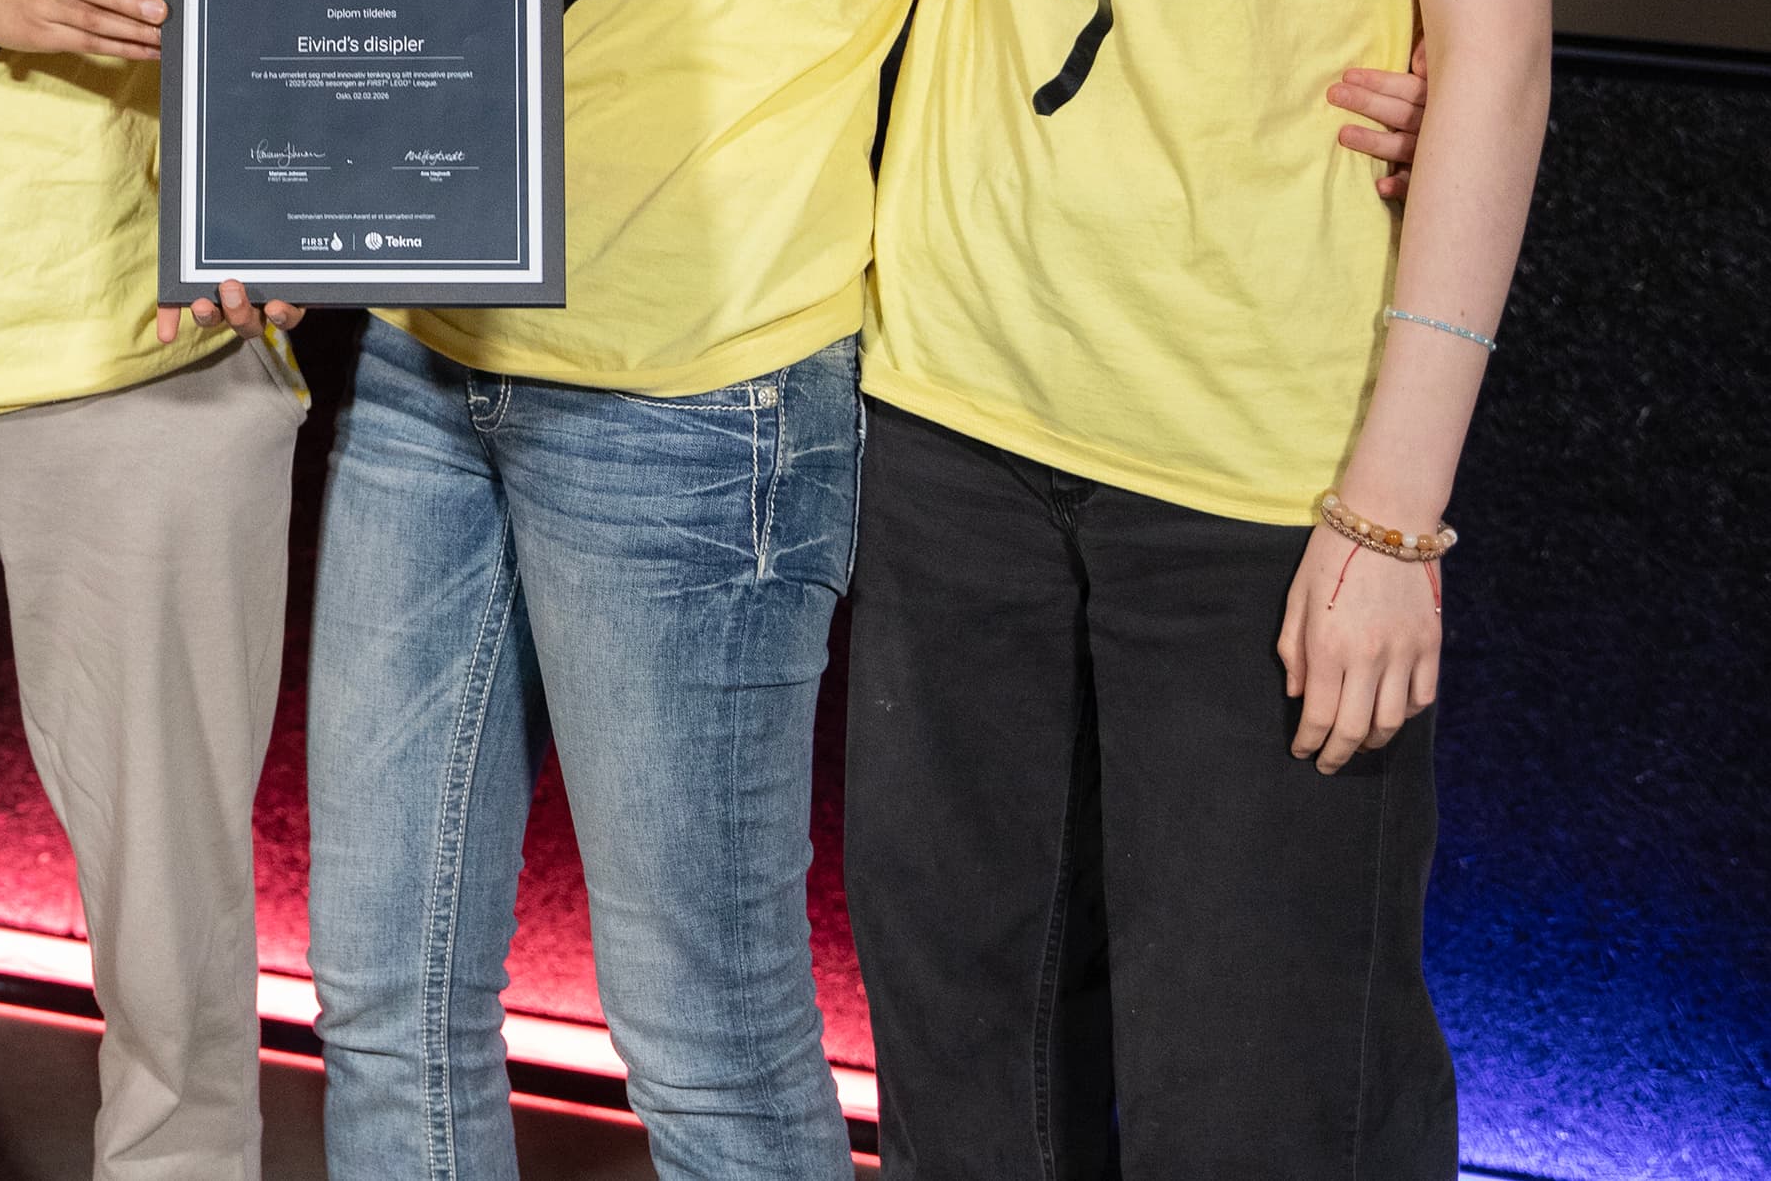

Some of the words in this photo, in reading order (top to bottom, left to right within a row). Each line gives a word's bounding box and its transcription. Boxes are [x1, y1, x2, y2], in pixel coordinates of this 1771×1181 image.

[327, 8, 360, 20] Diplom
[363, 7, 397, 19] tildeles
[297, 36, 359, 53] Eivind's
[363, 35, 425, 55] disipler
[321, 71, 336, 79] med
[301, 237, 329, 246] FIRST
[385, 235, 422, 248] Tekna
